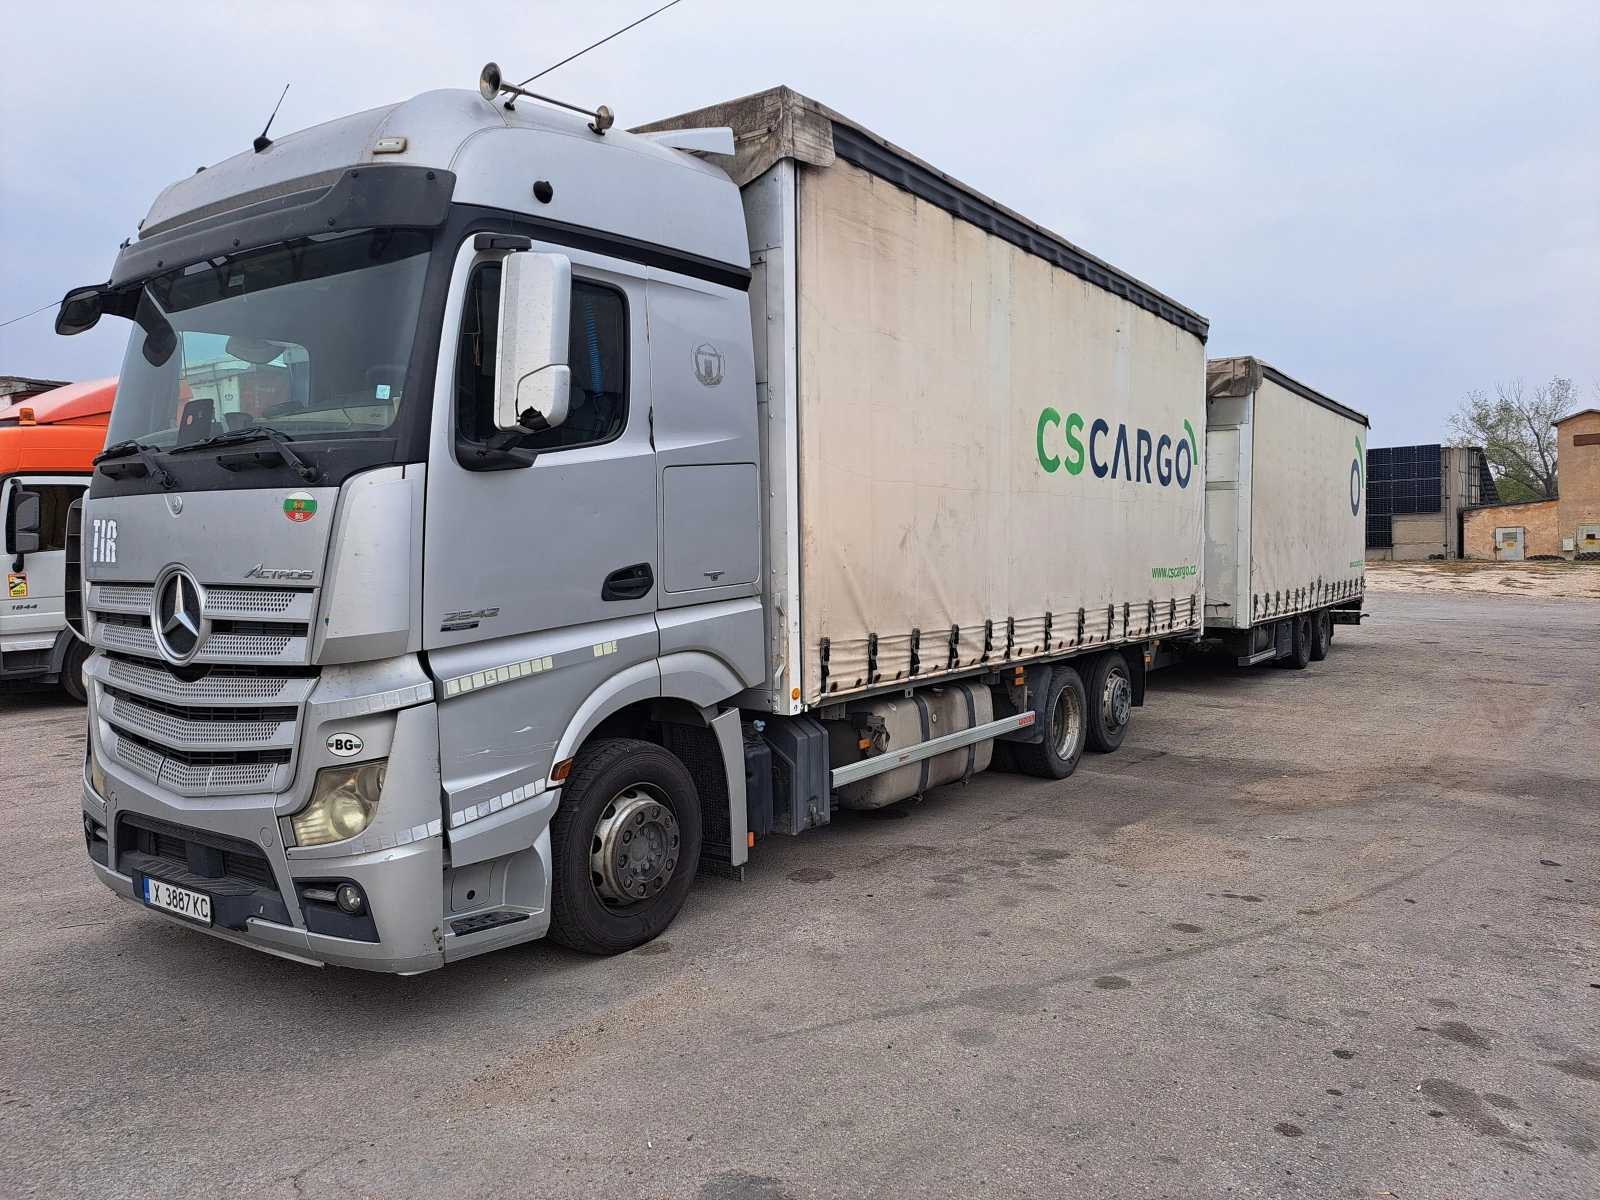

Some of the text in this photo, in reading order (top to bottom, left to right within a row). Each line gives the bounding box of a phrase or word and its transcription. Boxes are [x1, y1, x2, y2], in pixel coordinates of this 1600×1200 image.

[1036, 406, 1192, 489] CSCARGO
[295, 512, 304, 520] BG
[93, 519, 118, 563] TIR
[1151, 564, 1197, 580] www.cscargo.cz
[442, 606, 500, 622] 2542
[335, 738, 353, 751] BG
[153, 882, 161, 903] X
